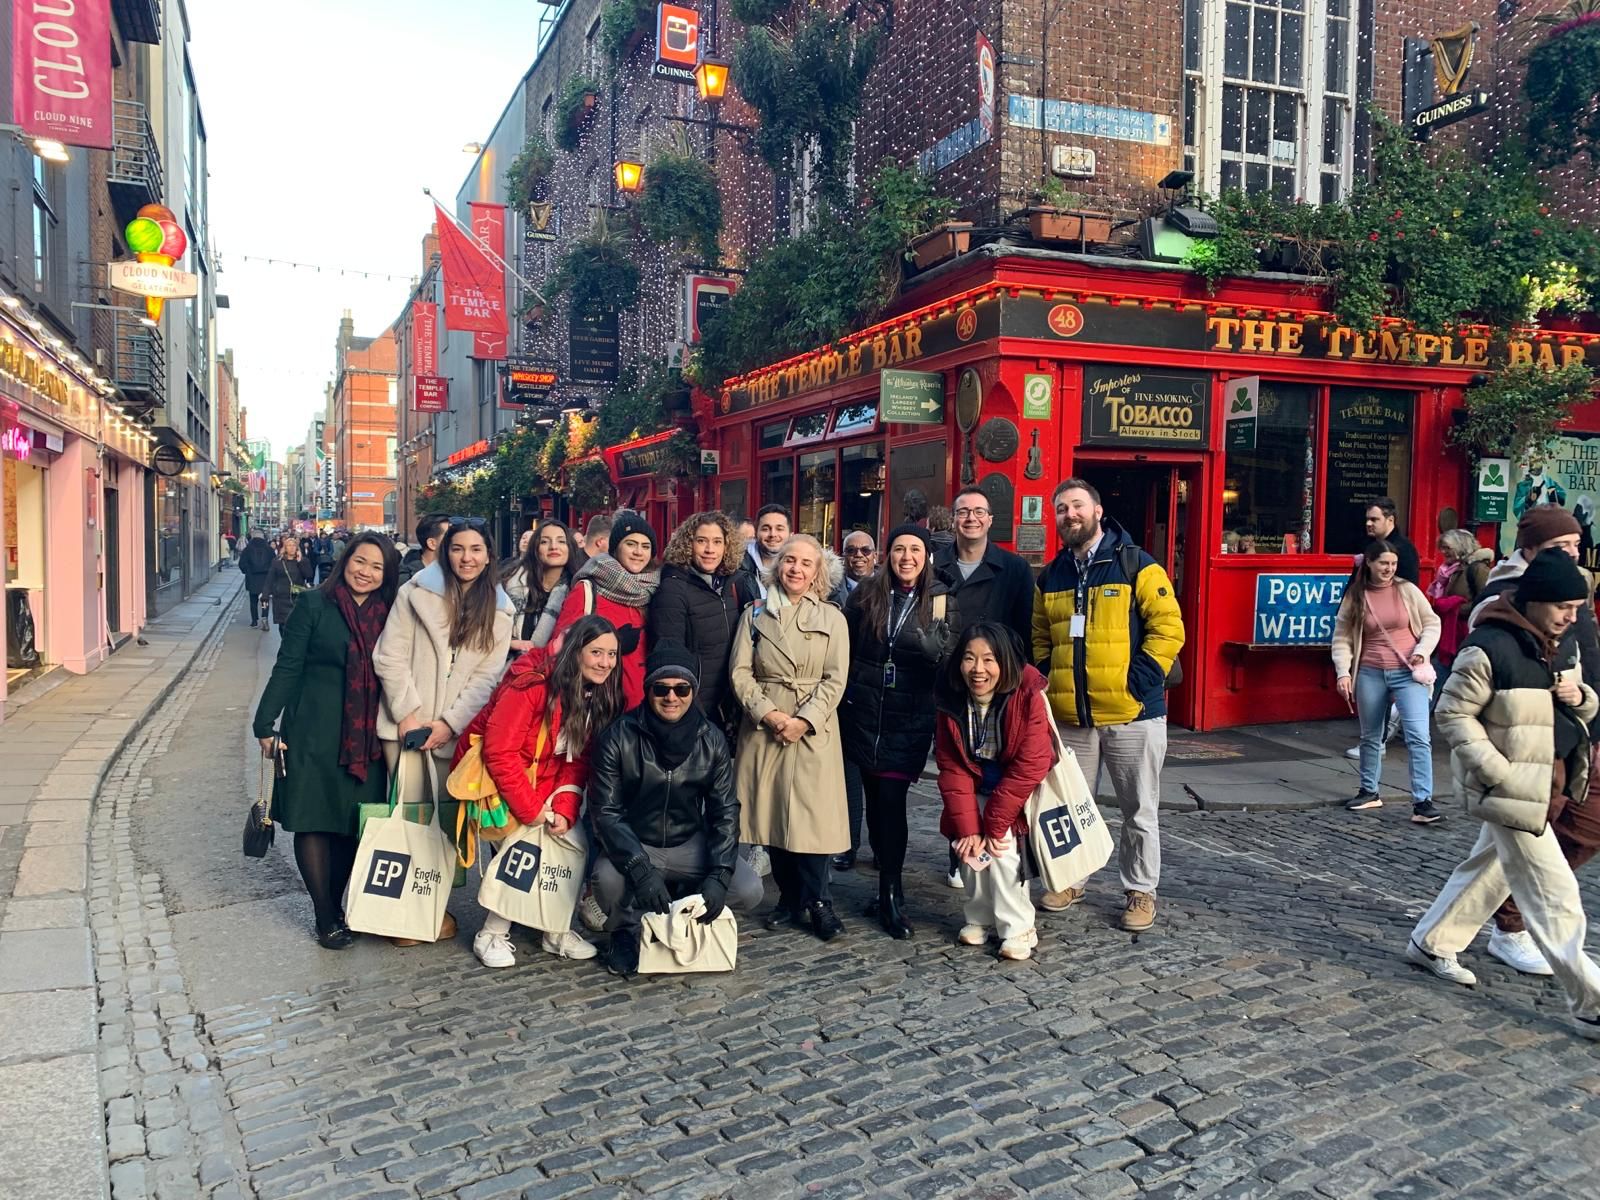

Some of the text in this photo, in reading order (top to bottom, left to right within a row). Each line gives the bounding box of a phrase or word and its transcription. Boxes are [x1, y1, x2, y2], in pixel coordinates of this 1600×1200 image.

[657, 64, 697, 80] GUINNES
[34, 110, 93, 128] CLOUD NINE
[1416, 94, 1472, 126] GUINNESS
[527, 231, 556, 241] GUINNESS
[122, 265, 187, 284] CLOUD NINE
[131, 282, 177, 293] GELATERIA
[450, 295, 501, 310] TEMPLE
[464, 307, 490, 317] BAR
[960, 315, 973, 336] 48
[1055, 308, 1076, 329] 48
[1208, 317, 1586, 370] THE TEMPLE BAR
[748, 328, 923, 405] THE TEMPLE BAR
[1089, 373, 1141, 396] Importers
[1135, 393, 1193, 404] FINE SMOKING
[1103, 396, 1193, 433] TOBACCO
[1340, 405, 1405, 423] TEMPLE BAR
[1120, 426, 1200, 439] Always in Stock
[1570, 444, 1598, 460] THE
[1568, 475, 1597, 492] BAR
[1268, 578, 1346, 604] POWE
[1259, 613, 1337, 639] WHIS
[1080, 812, 1097, 830] Path
[1046, 814, 1071, 848] EP
[370, 858, 403, 888] EP
[504, 847, 536, 880] EP
[414, 867, 442, 886] English
[411, 881, 432, 896] Path
